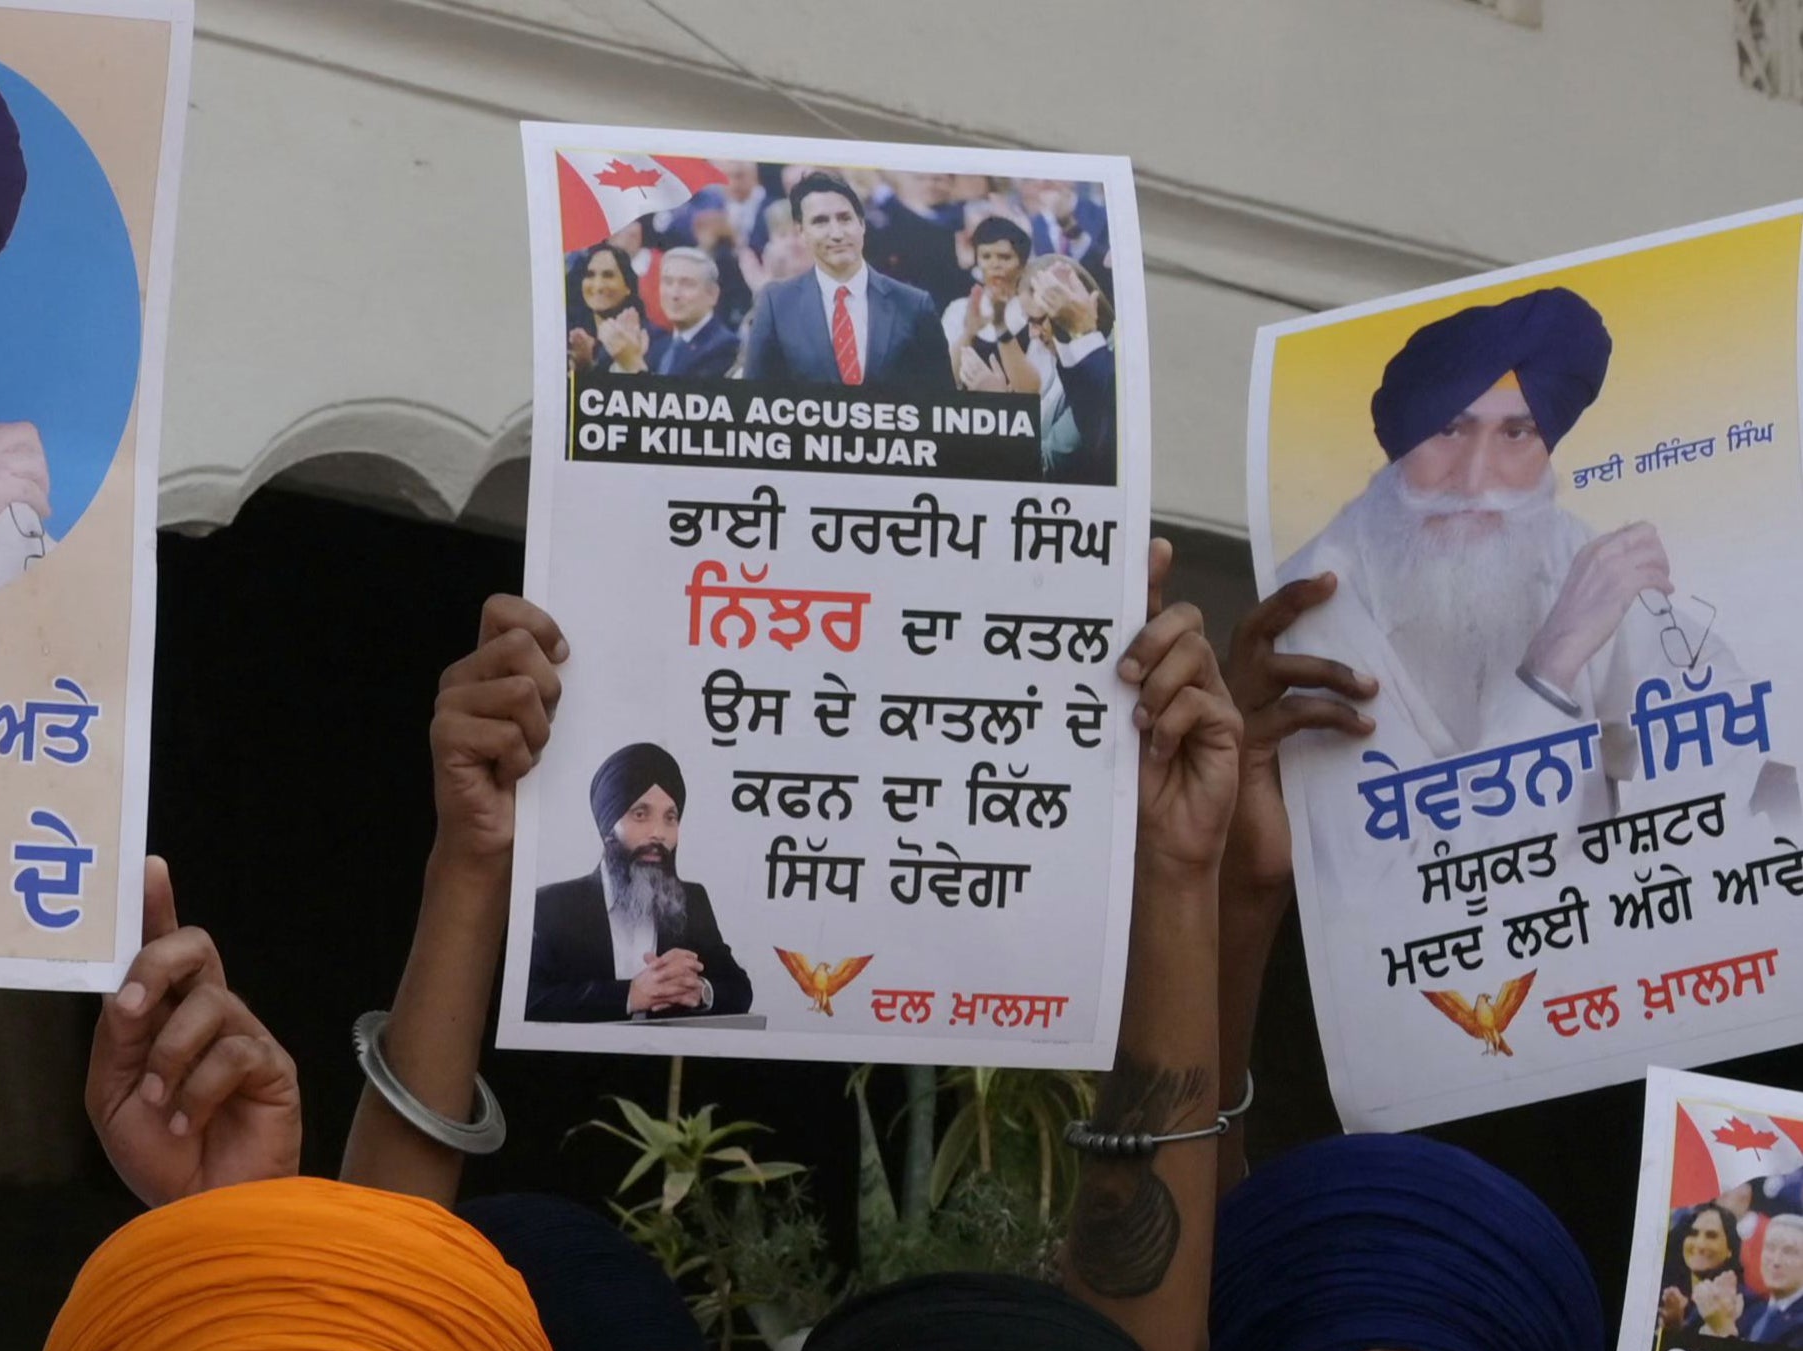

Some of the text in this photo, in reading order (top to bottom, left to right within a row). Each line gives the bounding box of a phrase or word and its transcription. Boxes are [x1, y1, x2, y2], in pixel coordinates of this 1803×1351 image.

[579, 389, 1035, 438] CANADA ACCUSES INDIA
[579, 425, 937, 467] OF KILLING NIJJAR
[1573, 420, 1774, 488] ਭਾਈ ਗਜਿੰਦਰ ਸਿੰਘ
[668, 485, 1117, 566] ਭਾਈ ਹਰਦੀਪ ਸਿੰਘ
[685, 560, 1112, 663] ਨਿੱਝਰ ਦਾ ਕਤਲ
[702, 669, 1107, 748] ਉਸ ਦੇ ਕਾਤਲਾਂ ਦੇ
[1358, 665, 1772, 841] ਬੇਵਤਨਾ ਸਿੱਖ
[731, 762, 1070, 828] ਕਫਨ ਦਾ ਕਿੱਲ
[14, 811, 93, 929] ਦੇ
[765, 835, 1030, 908] ਸਿੱਧ ਹੋਵੇਗਾ
[1418, 793, 1725, 916] ਸੰਯੂਕਤ ਰਾਸ਼ਟਰ
[1381, 926, 1483, 987] ਮਦਦ
[1503, 887, 1589, 959] ਲਈ
[1610, 863, 1692, 930] ਅੱਗੇ
[871, 988, 1069, 1028] ਦਲ ਖ਼ਾਲਸਾ
[1543, 949, 1778, 1037] ਦਲ ਖ਼ਾਲਸਾ
